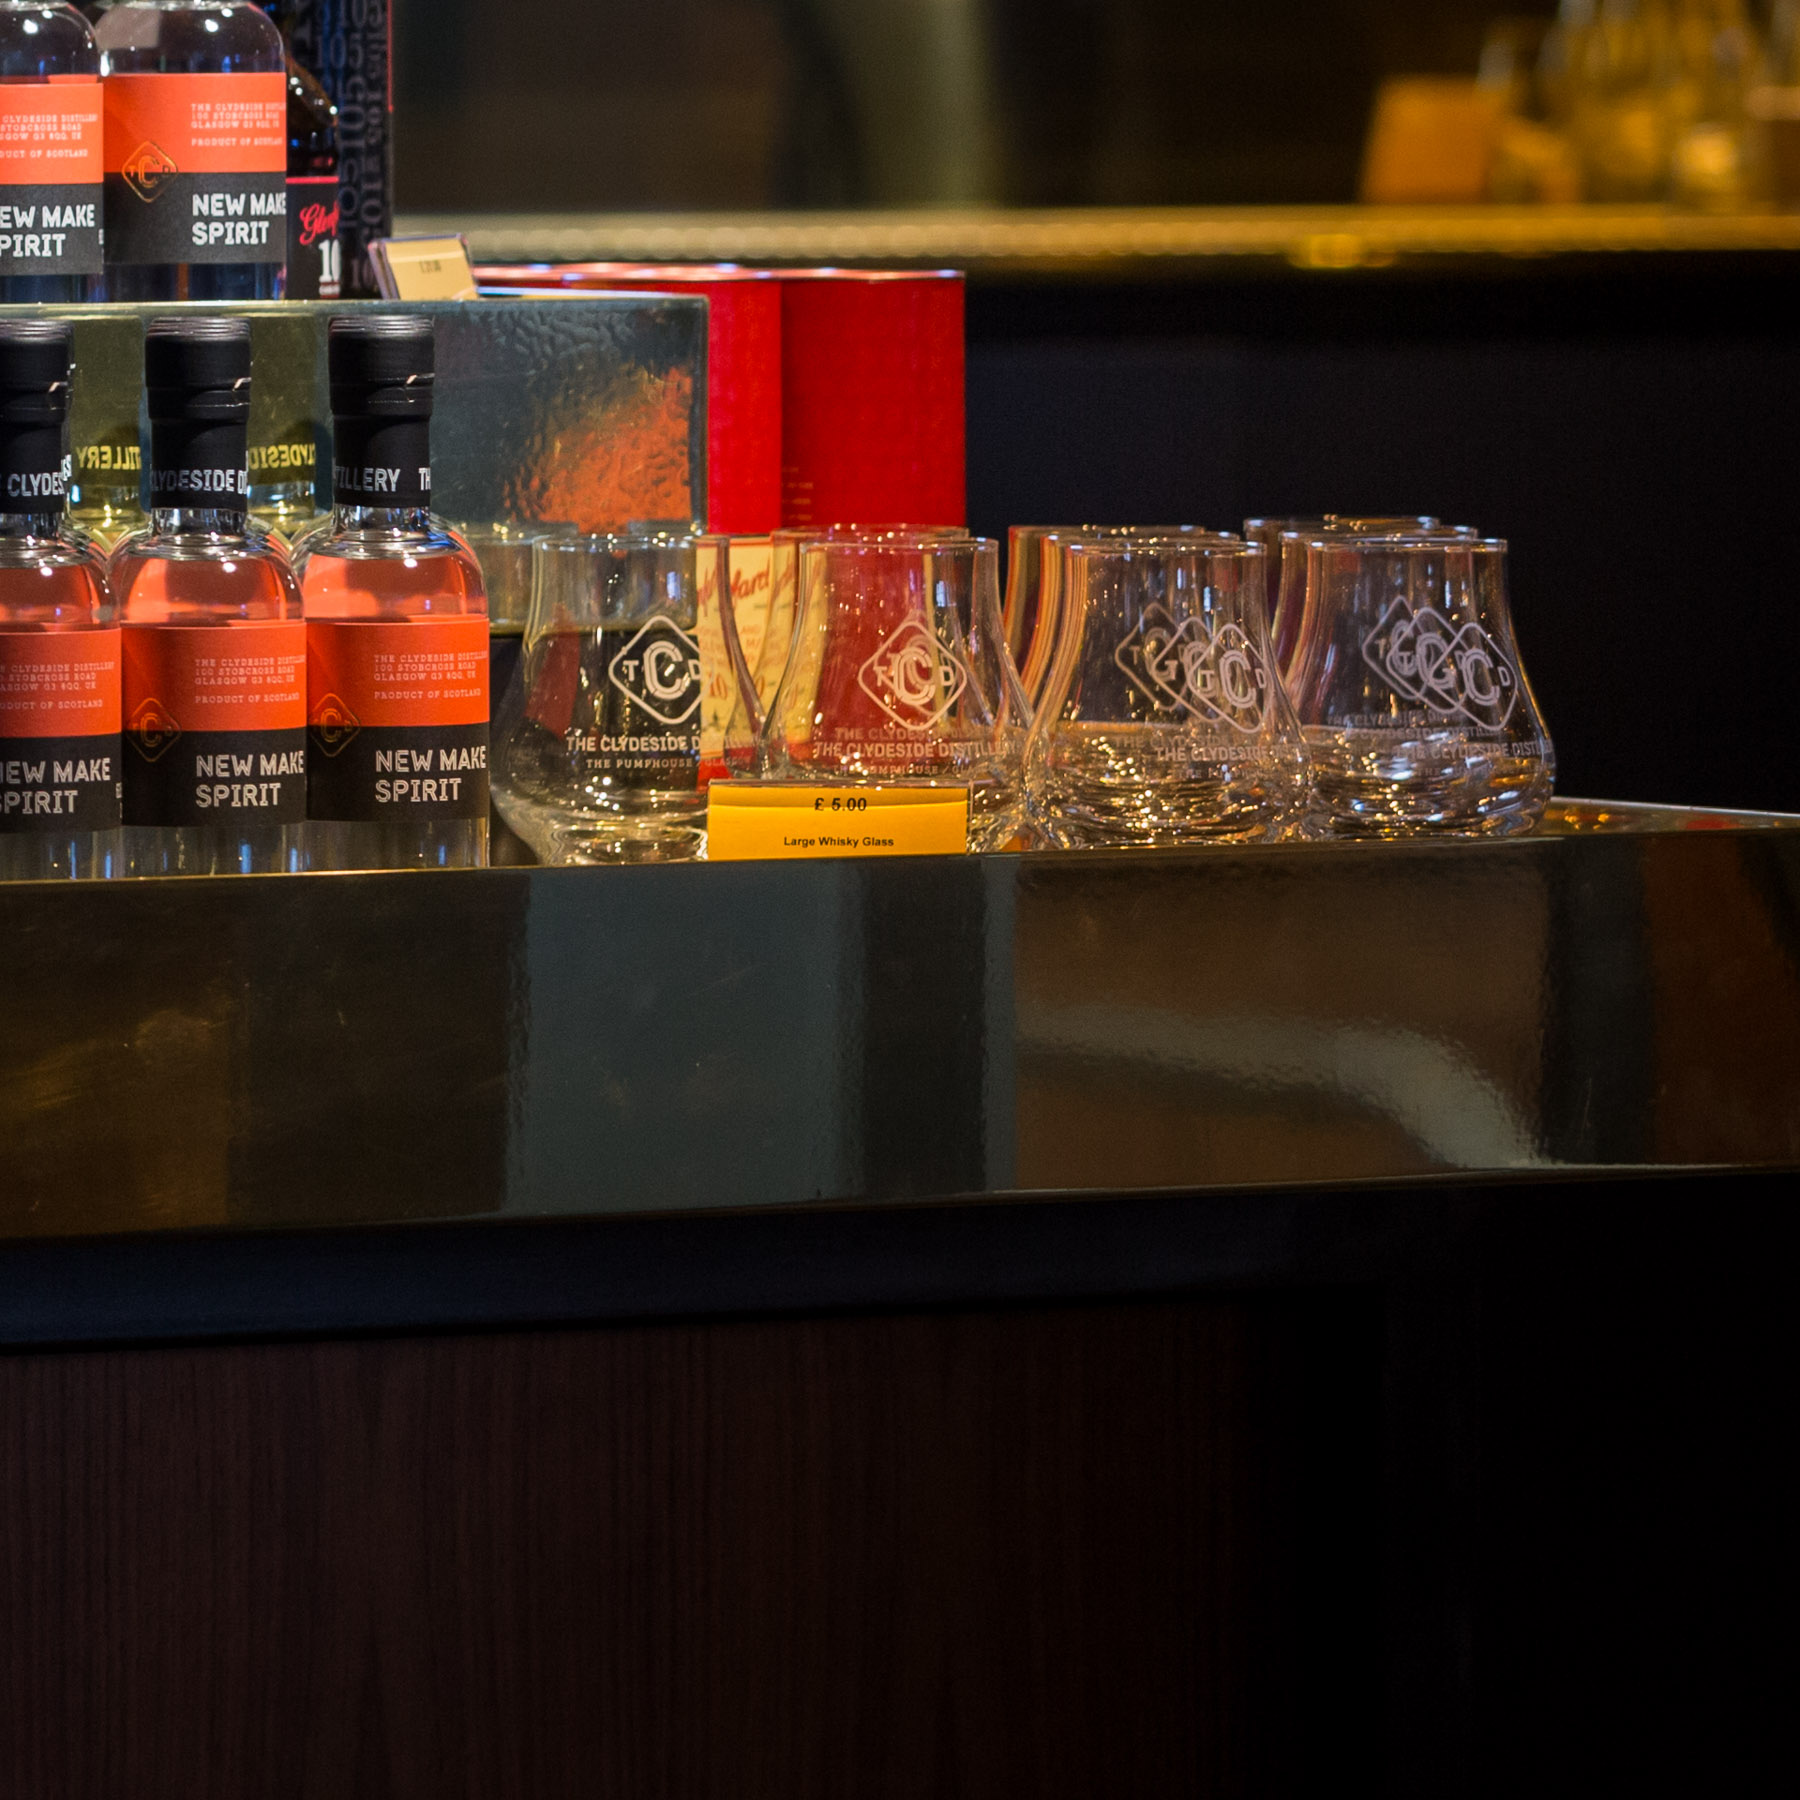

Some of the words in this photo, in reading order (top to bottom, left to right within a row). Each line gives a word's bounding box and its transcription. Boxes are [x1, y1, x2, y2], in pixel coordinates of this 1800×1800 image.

[191, 103, 211, 111] THE
[214, 103, 263, 111] CLYDESIDE
[191, 138, 236, 146] PRODUCT
[30, 150, 42, 158] OF
[192, 193, 246, 216] NEW
[250, 192, 286, 215] MAKE
[41, 204, 96, 227] MAKE
[192, 221, 270, 246] SPIRIT
[195, 659, 216, 667] THE
[221, 658, 274, 666] CLYDESIDE
[374, 655, 395, 663] THE
[400, 654, 454, 662] CLYDESIDE
[374, 673, 426, 681] GLASGOW
[374, 691, 423, 700] PRODUCT
[566, 735, 596, 752] THE
[600, 735, 687, 752] CLYDESIDE
[813, 741, 844, 758] THE
[847, 741, 934, 757] CLYDESIDE
[376, 750, 432, 773] NEW
[440, 746, 486, 771] MAKE
[1156, 747, 1187, 761] THE
[53, 758, 111, 782] MAKE
[196, 755, 253, 777] NEW
[260, 751, 304, 776] MAKE
[586, 759, 612, 768] THE
[616, 758, 692, 768] PUMPHOUSE
[196, 783, 281, 808] SPIRIT
[376, 778, 462, 803] SPIRIT
[814, 798, 825, 812] £
[830, 797, 868, 812] 5.00
[784, 837, 815, 849] Large
[819, 836, 857, 849] Whisky
[860, 836, 894, 848] Glass
